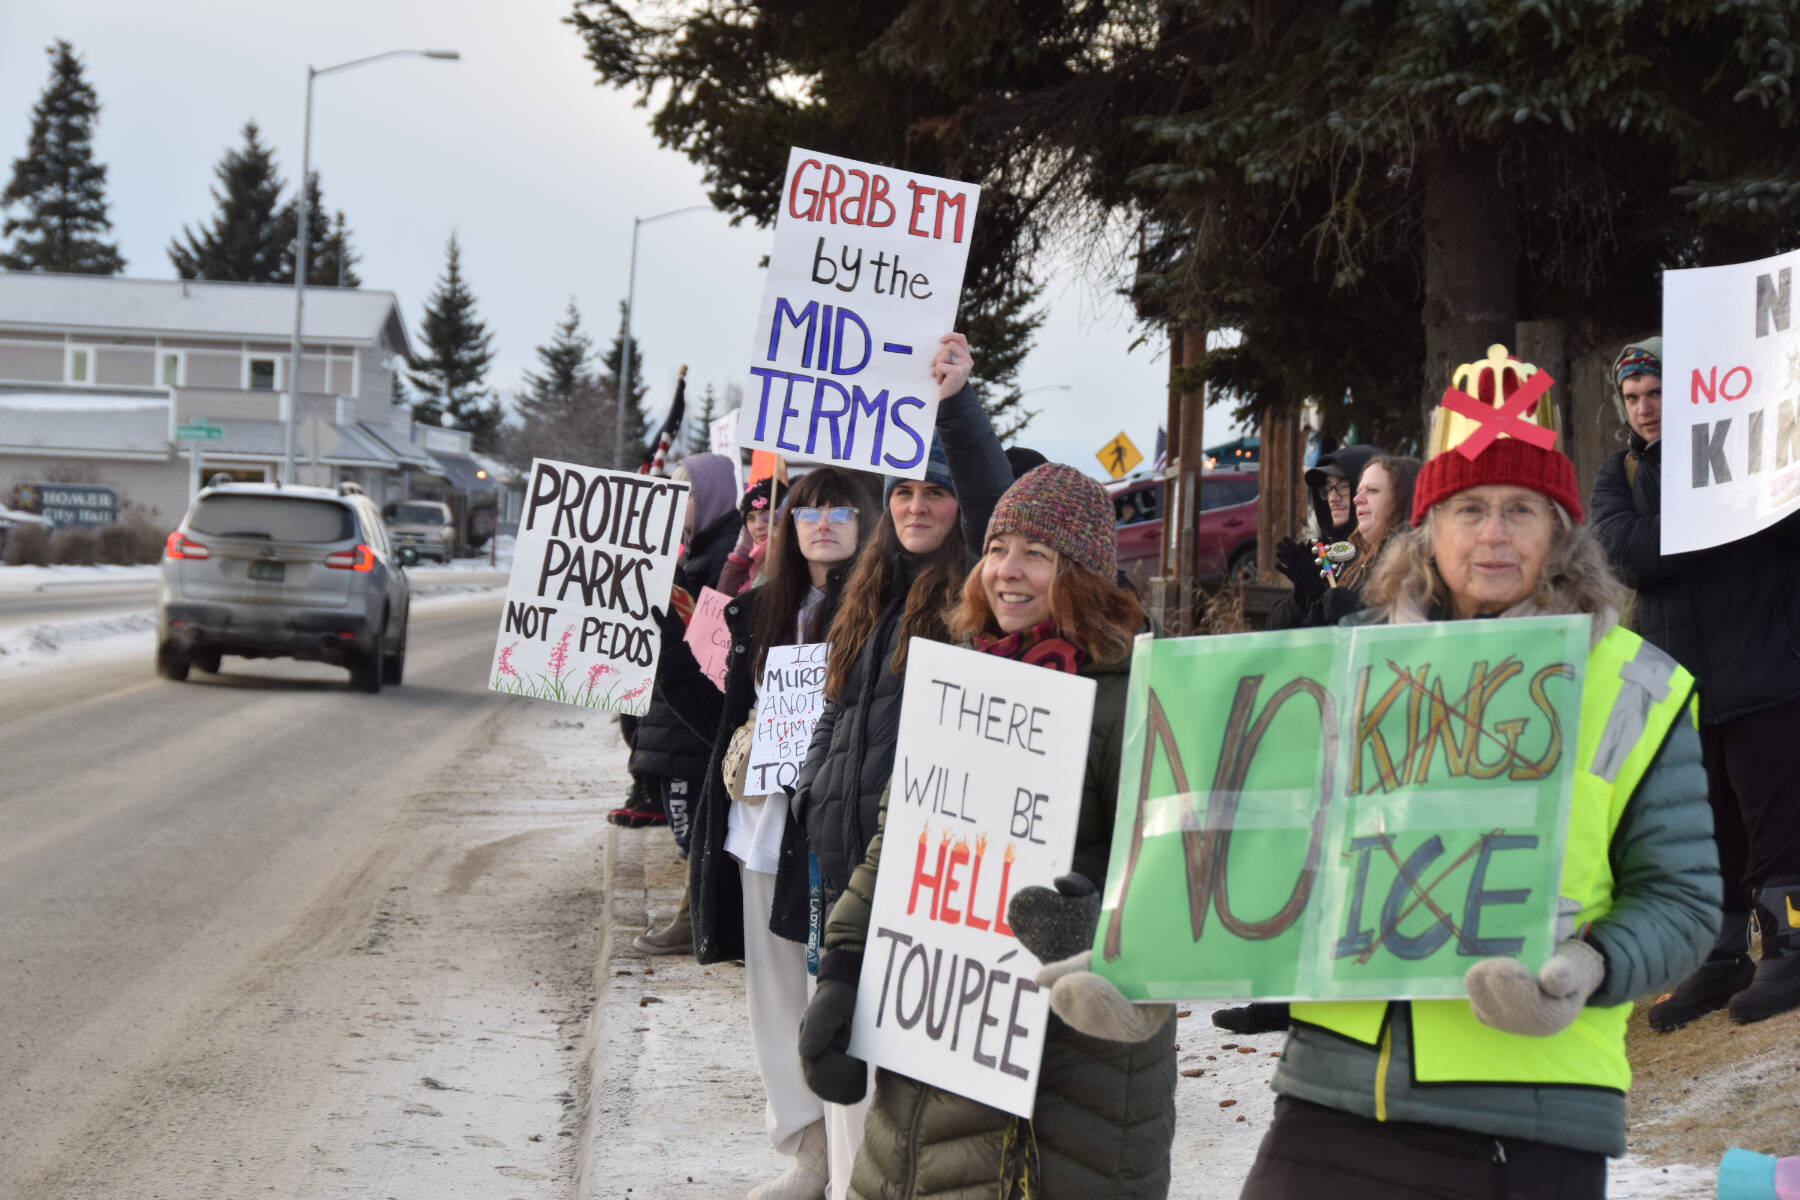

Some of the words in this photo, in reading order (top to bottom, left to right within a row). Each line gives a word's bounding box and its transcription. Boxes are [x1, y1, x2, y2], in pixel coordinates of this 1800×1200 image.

[812, 236, 862, 292] by
[870, 251, 933, 300] the
[750, 366, 926, 469] TERMS
[1690, 365, 1752, 404] NO
[526, 463, 689, 556] PROTECT
[537, 539, 653, 620] PARKS
[505, 600, 557, 641] NOT
[579, 616, 655, 667] PEDOS
[932, 678, 1050, 755] THERE
[904, 756, 976, 823] WILL
[1010, 787, 1049, 845] BE
[1103, 674, 1339, 962] NO
[1350, 656, 1575, 798] KINGS
[809, 898, 819, 929] LADY
[906, 824, 1016, 937] HELL
[1332, 833, 1539, 962] ICE
[807, 933, 818, 963] GRAY
[876, 927, 1040, 1080] TOUPÉE
